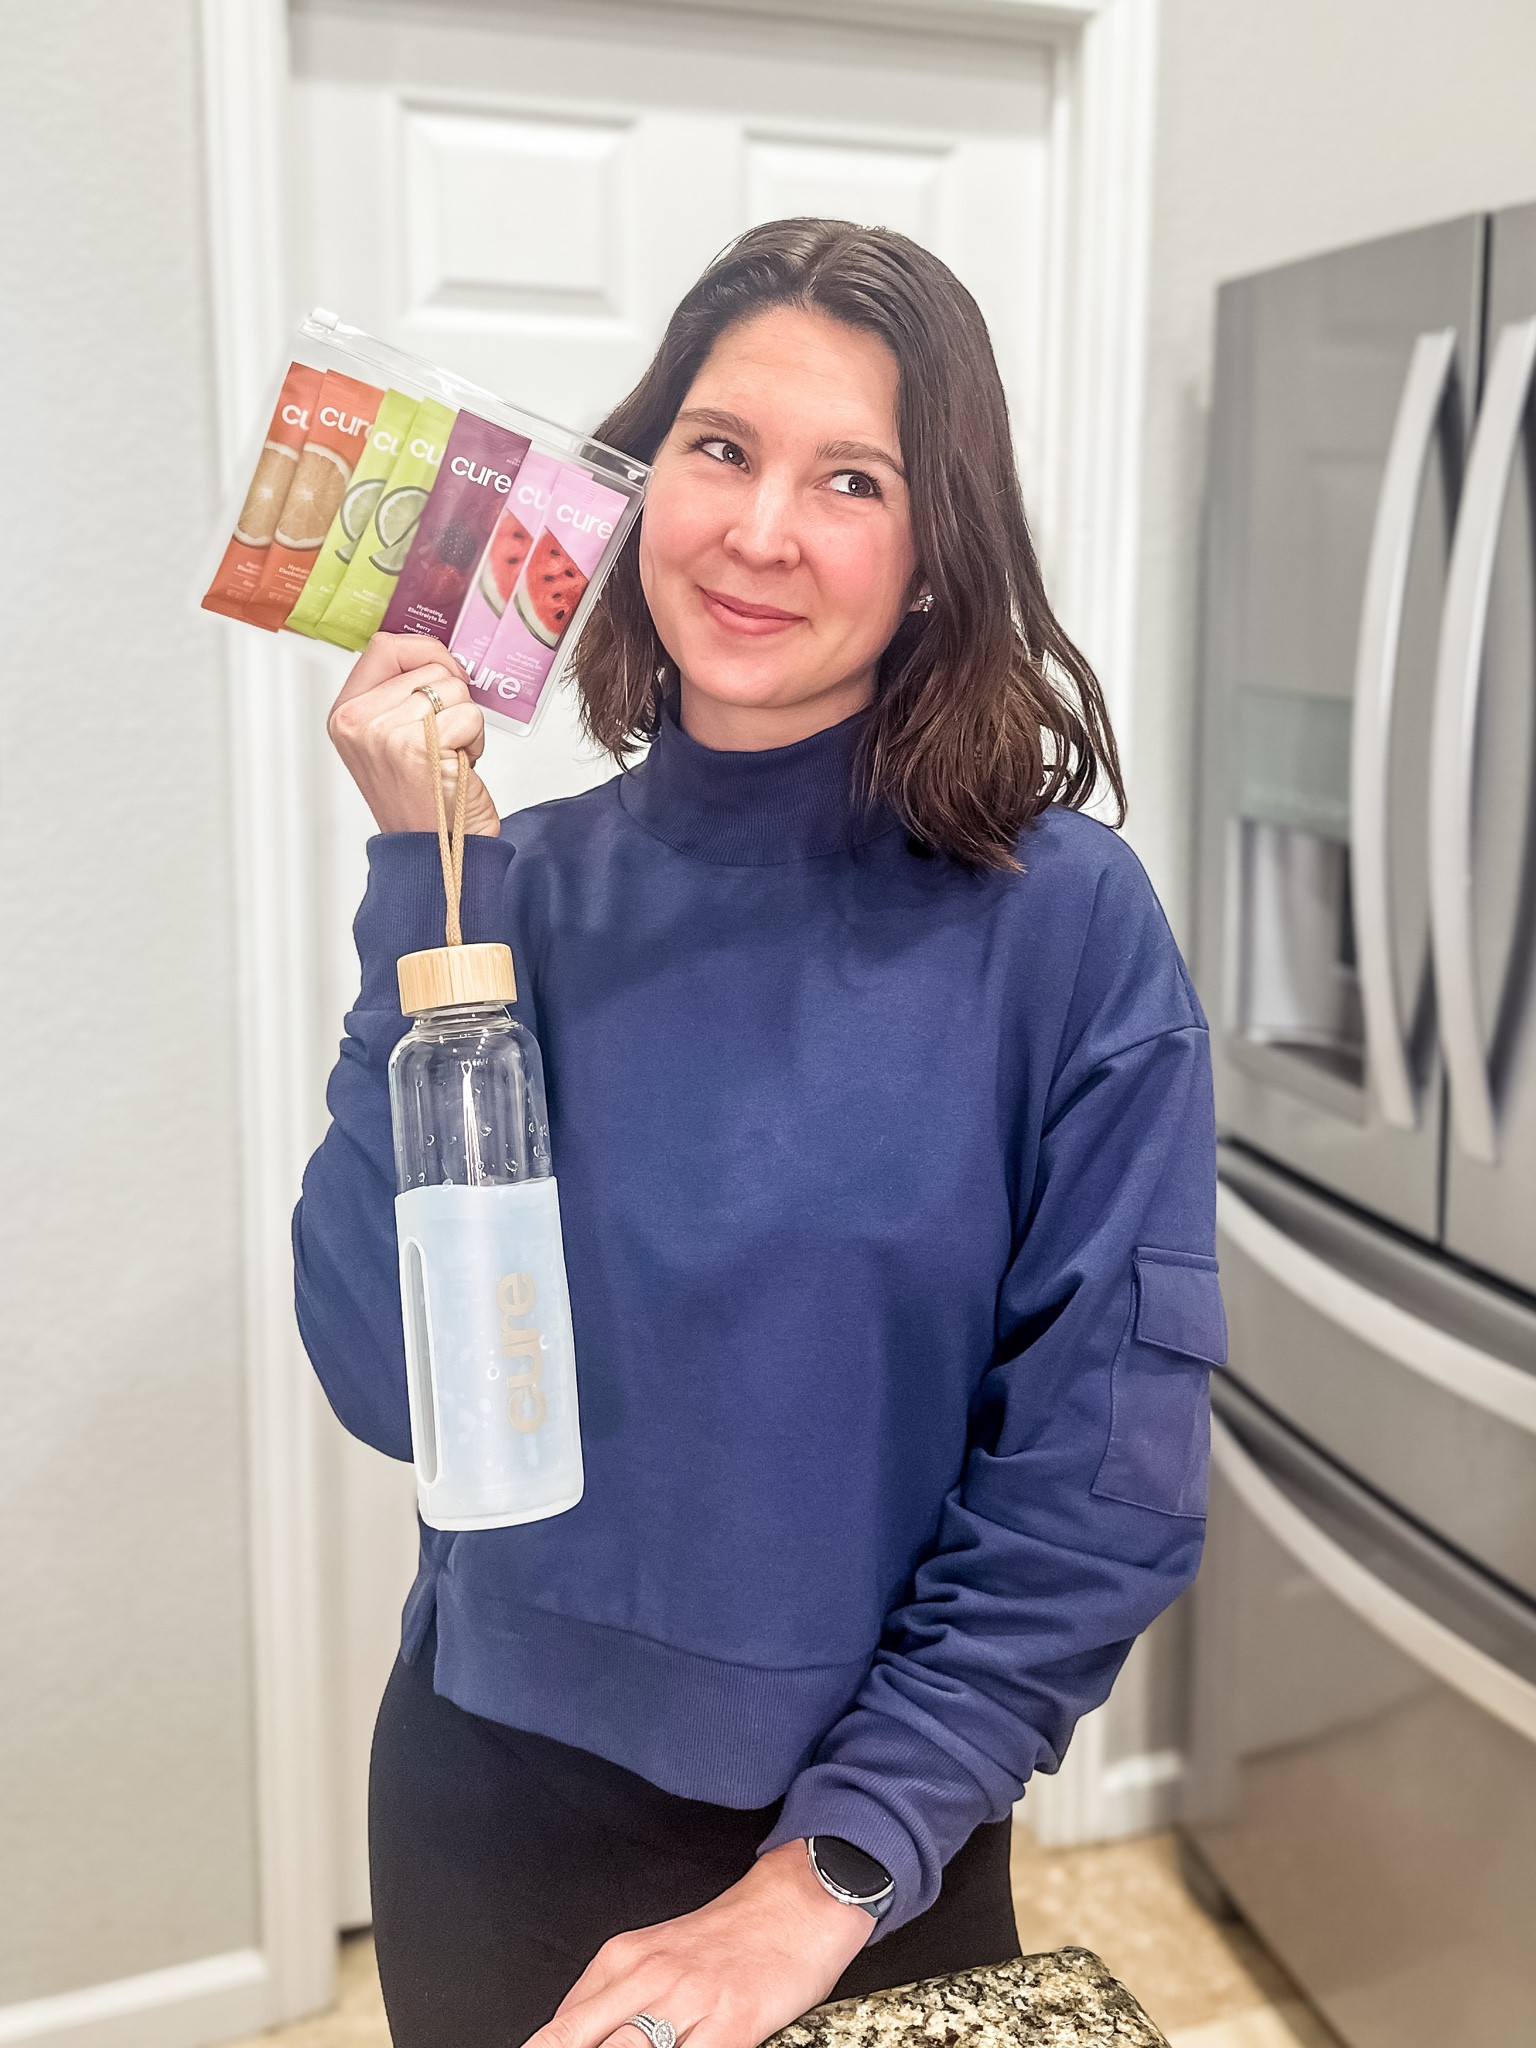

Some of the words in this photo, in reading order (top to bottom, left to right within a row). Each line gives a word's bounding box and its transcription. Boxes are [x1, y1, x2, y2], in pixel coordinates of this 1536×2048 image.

[450, 456, 512, 494] cure
[556, 504, 614, 540] cure
[407, 606, 438, 622] Electrolyte
[416, 603, 443, 618] Hydrating
[415, 622, 431, 633] Berry
[497, 1272, 547, 1434] cure
